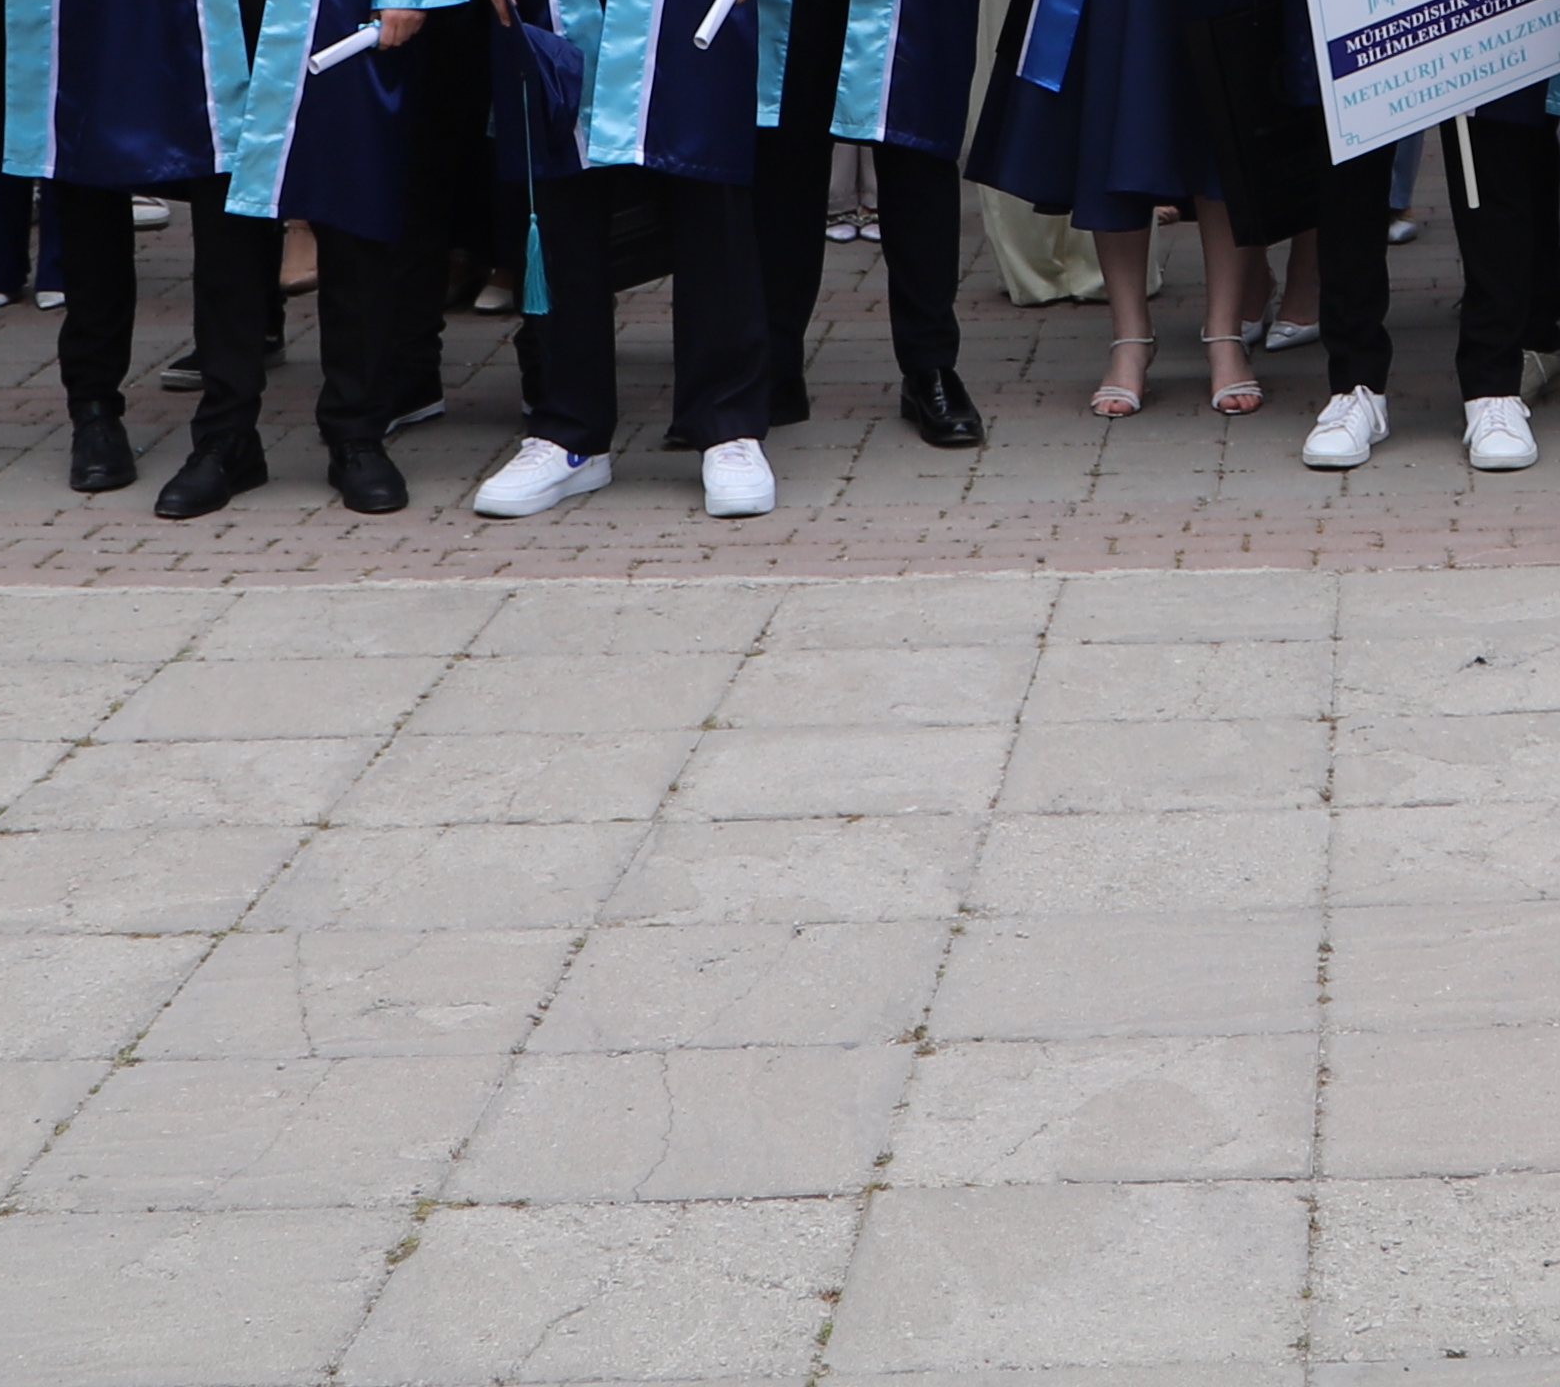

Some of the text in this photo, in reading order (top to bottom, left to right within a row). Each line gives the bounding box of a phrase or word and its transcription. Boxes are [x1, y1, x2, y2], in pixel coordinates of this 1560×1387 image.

[1343, 58, 1445, 108] METALURJİ
[1450, 45, 1474, 65] VE
[1356, 22, 1447, 68] BİLİMLERİ
[1388, 47, 1527, 115] MÜHENDİSLİĞİ
